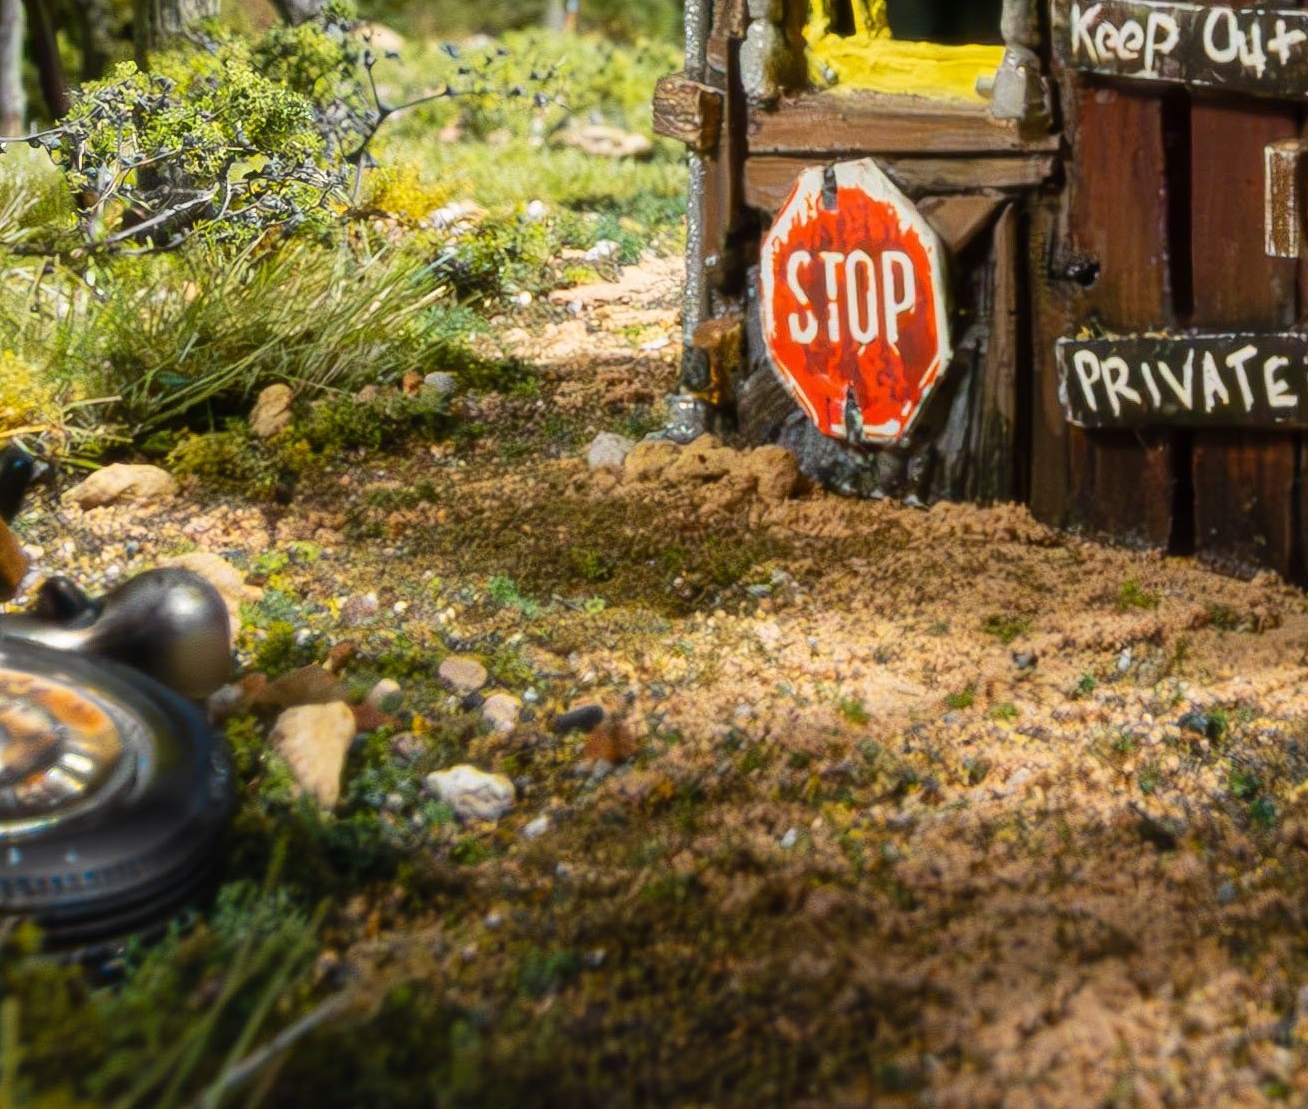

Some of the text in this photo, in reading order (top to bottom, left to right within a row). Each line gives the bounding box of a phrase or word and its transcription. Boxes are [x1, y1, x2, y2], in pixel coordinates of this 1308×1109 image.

[1203, 7, 1307, 79] Out
[787, 249, 916, 344] STOP
[1073, 344, 1298, 417] PRIVATE
